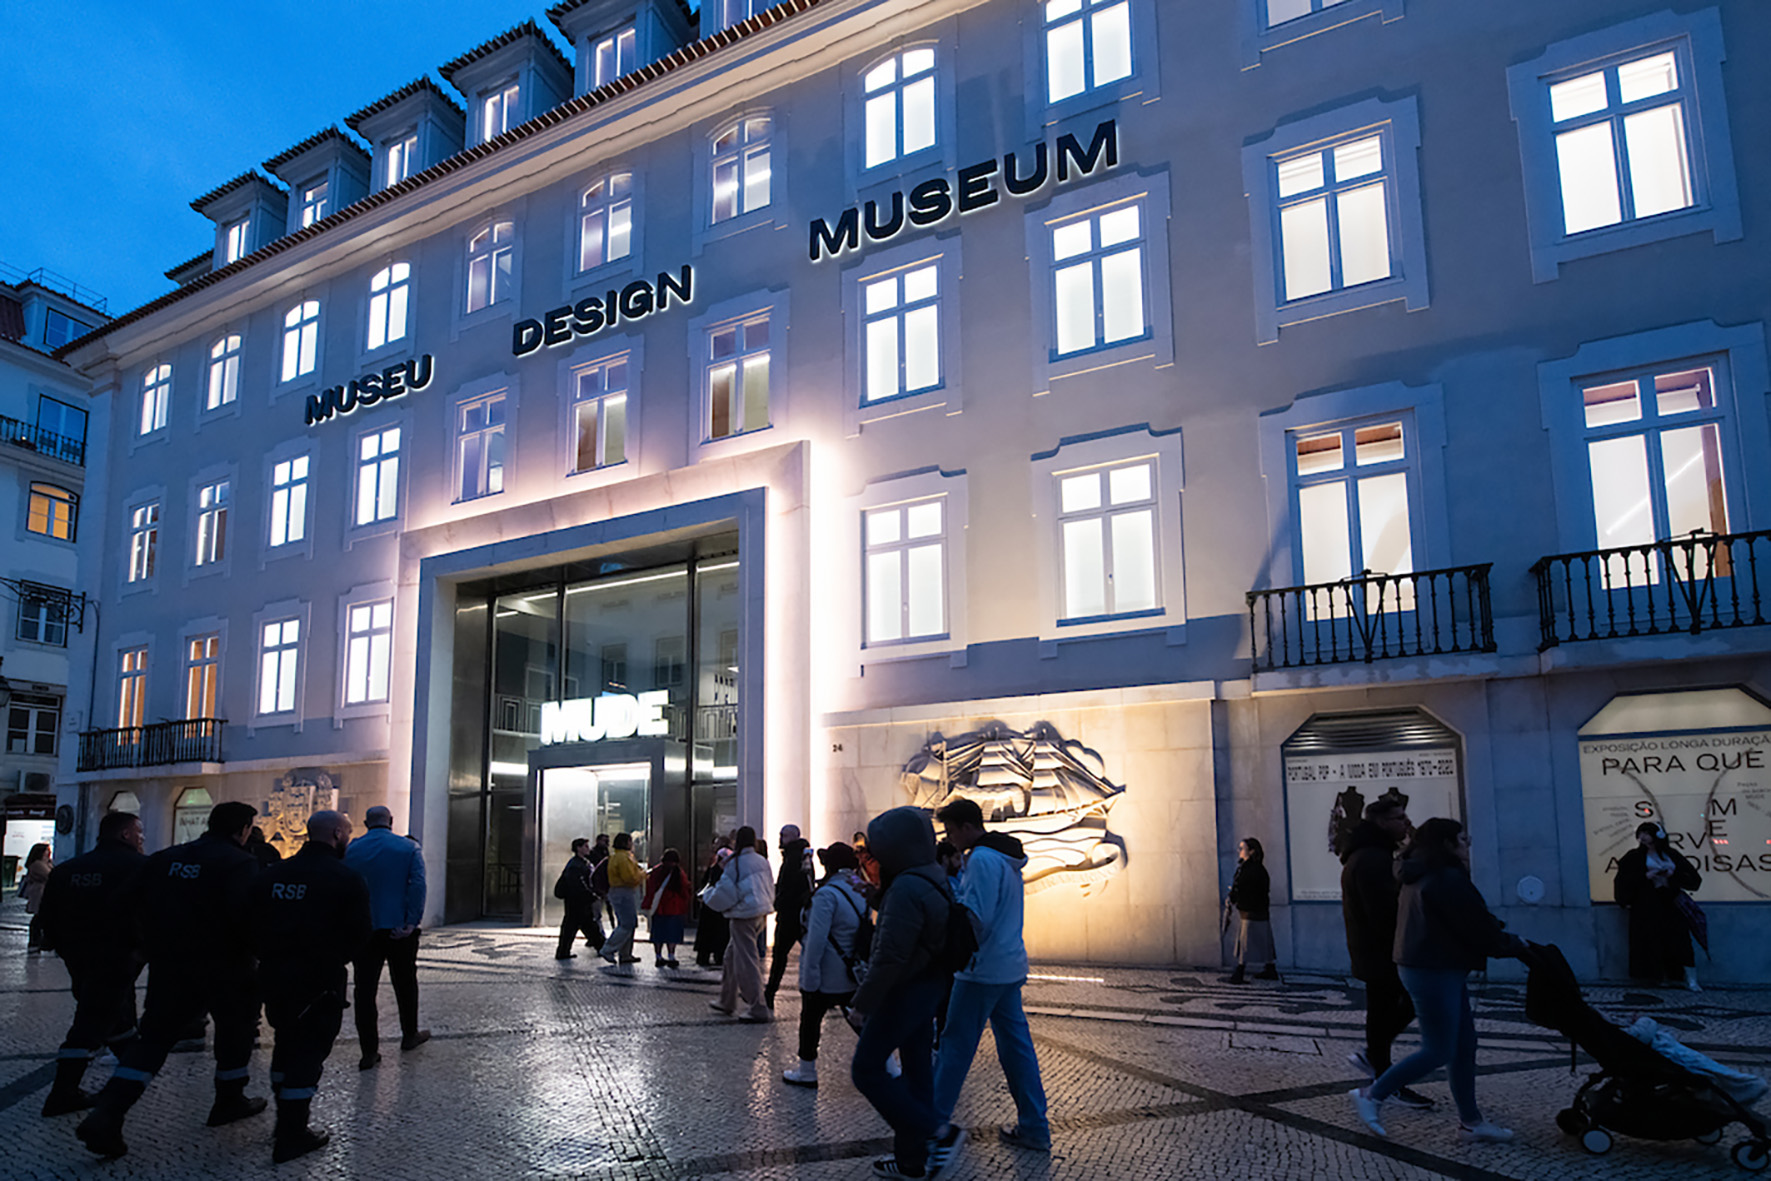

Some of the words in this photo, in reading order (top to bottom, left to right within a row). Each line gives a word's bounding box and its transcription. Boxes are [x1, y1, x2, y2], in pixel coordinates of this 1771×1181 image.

[809, 118, 1118, 262] MUSEUM
[512, 264, 694, 356] DESIGN
[304, 354, 434, 427] MUSEU
[540, 689, 669, 746] MUDE
[1583, 741, 1658, 755] EXPOSIÇÃO
[1660, 738, 1709, 751] LONGA
[1712, 734, 1771, 748] DURAÇÃ
[1601, 755, 1686, 776] PARA
[1696, 750, 1765, 772] QUE
[168, 861, 201, 879] RSB
[1685, 853, 1771, 873] OISAS
[70, 872, 102, 887] RSB
[271, 883, 307, 900] RSB
